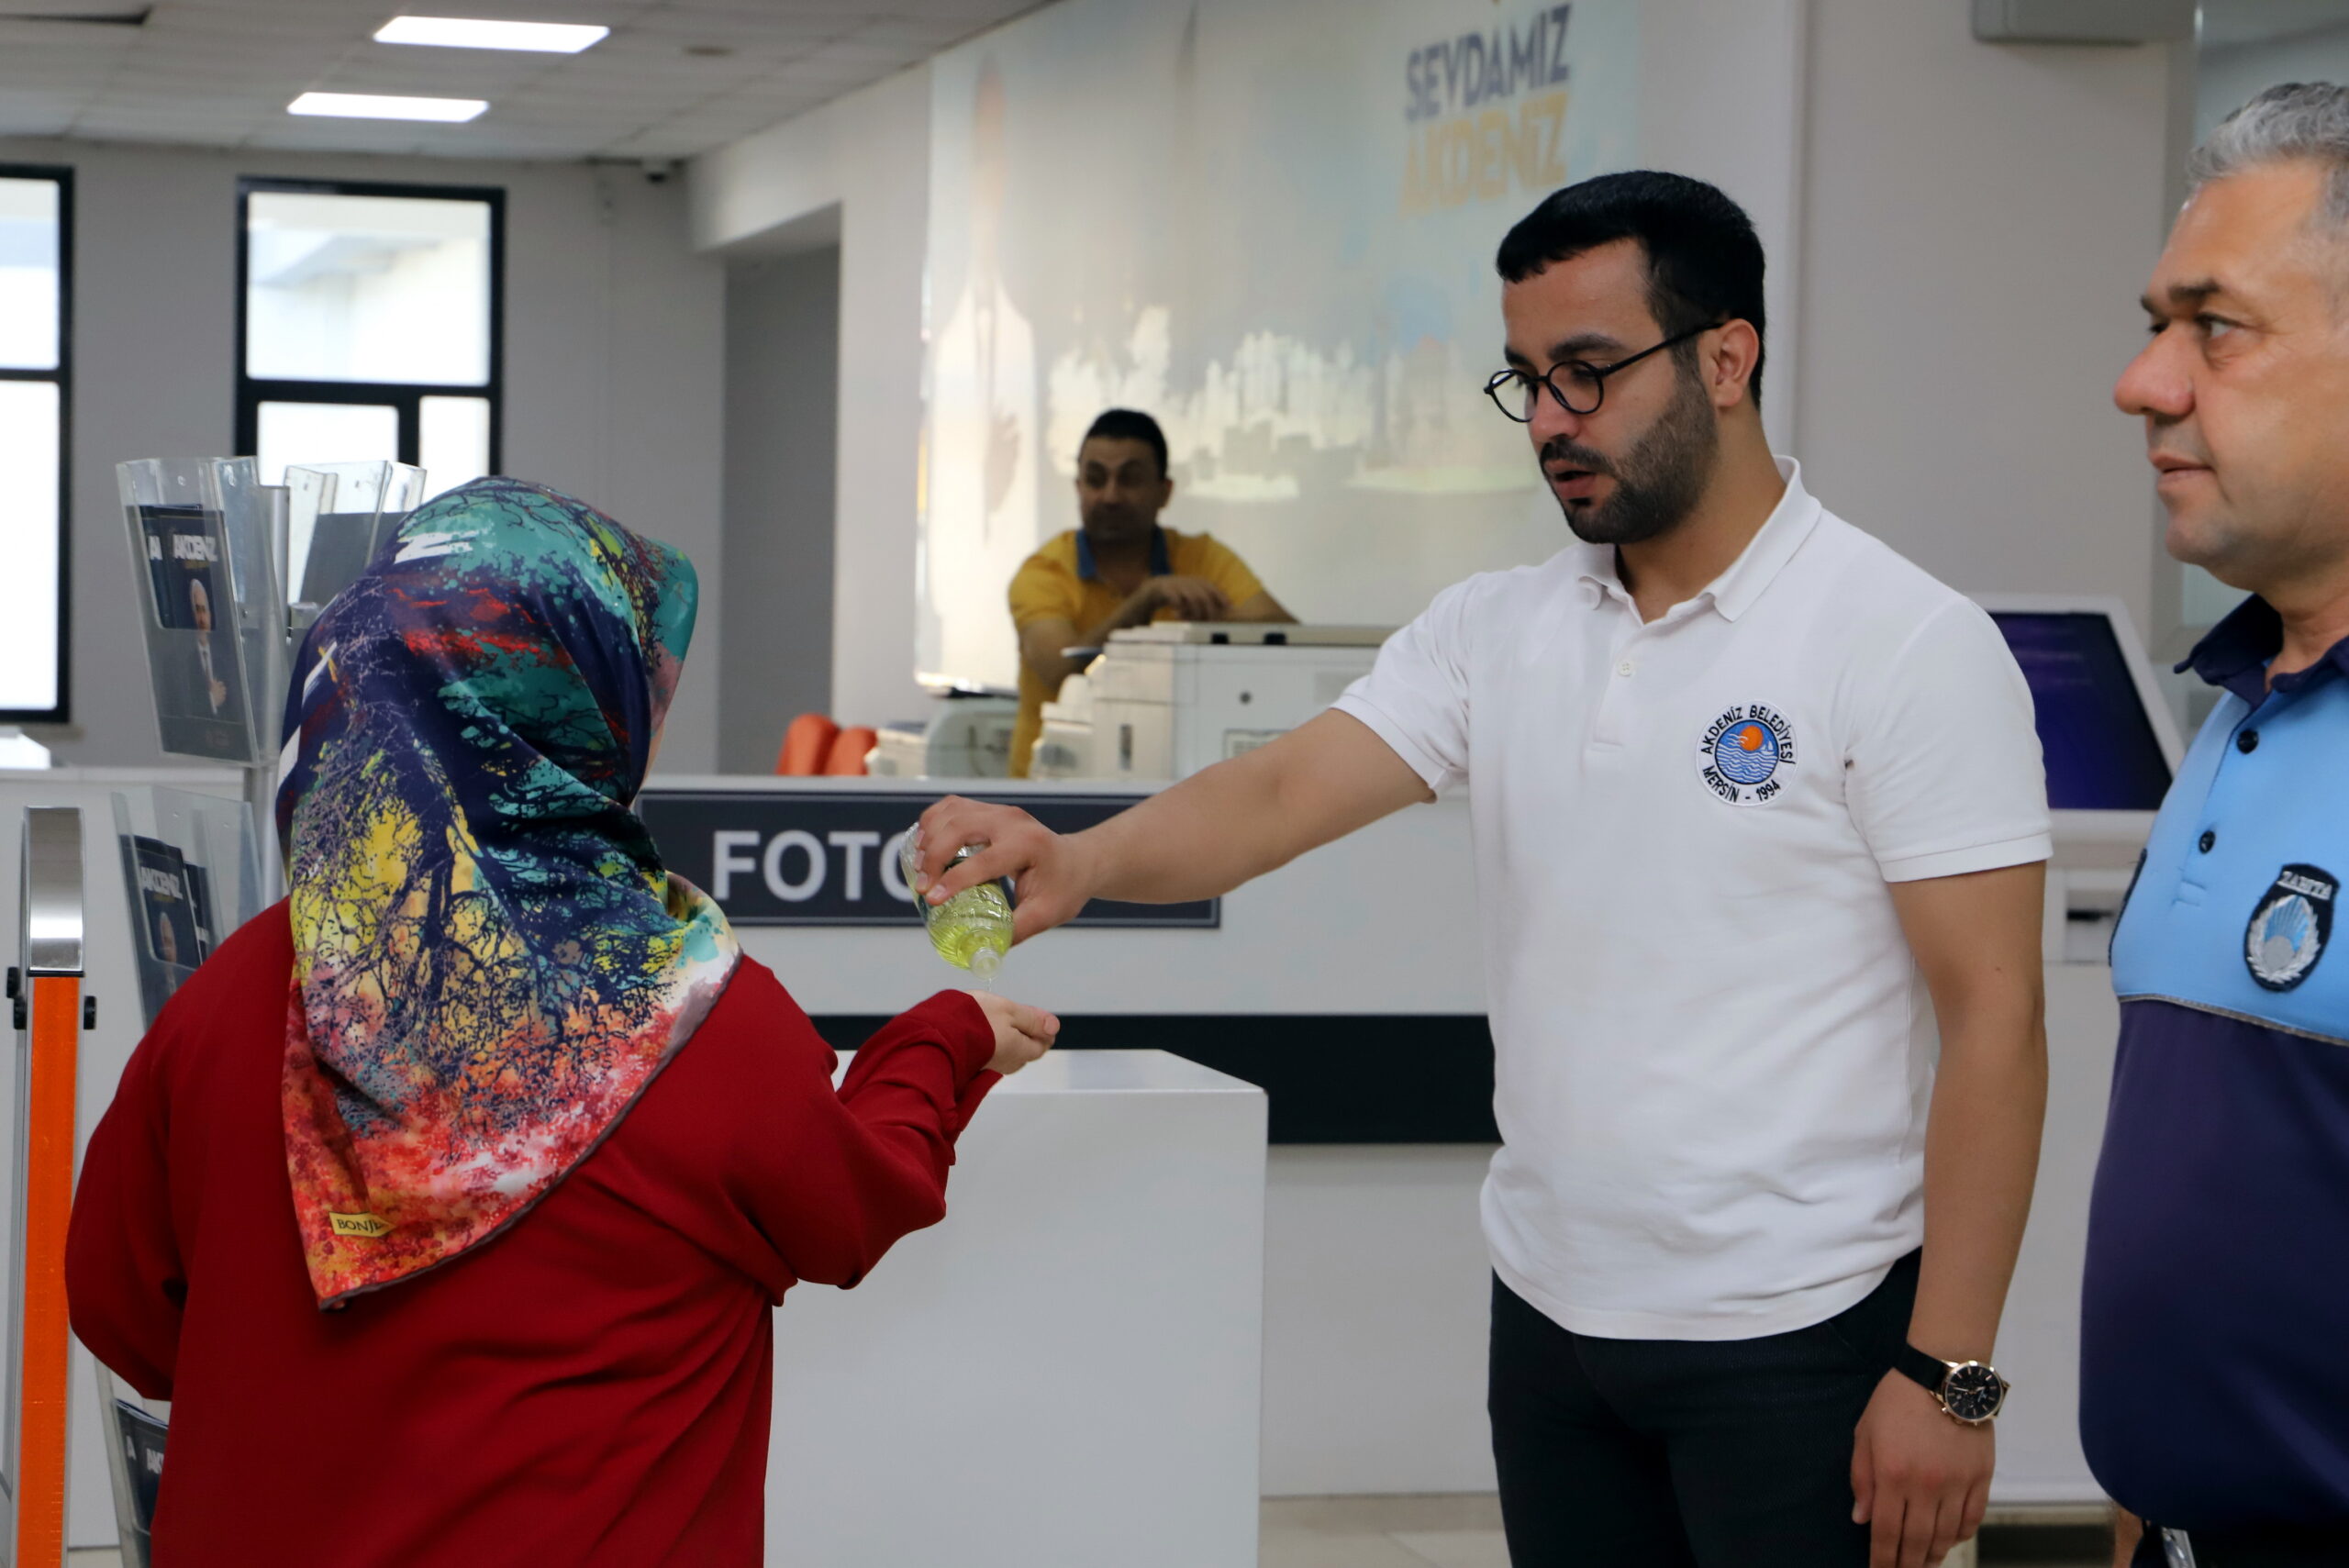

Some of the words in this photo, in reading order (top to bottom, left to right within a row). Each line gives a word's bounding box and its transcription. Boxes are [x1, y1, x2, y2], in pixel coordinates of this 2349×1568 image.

[1405, 3, 1571, 122] SEVDAMIZ
[1700, 706, 1743, 755] AKDENİZ
[1749, 704, 1797, 765] BELEDİYESİ
[1702, 764, 1740, 803] MERSİN
[1755, 779, 1782, 802] 1994
